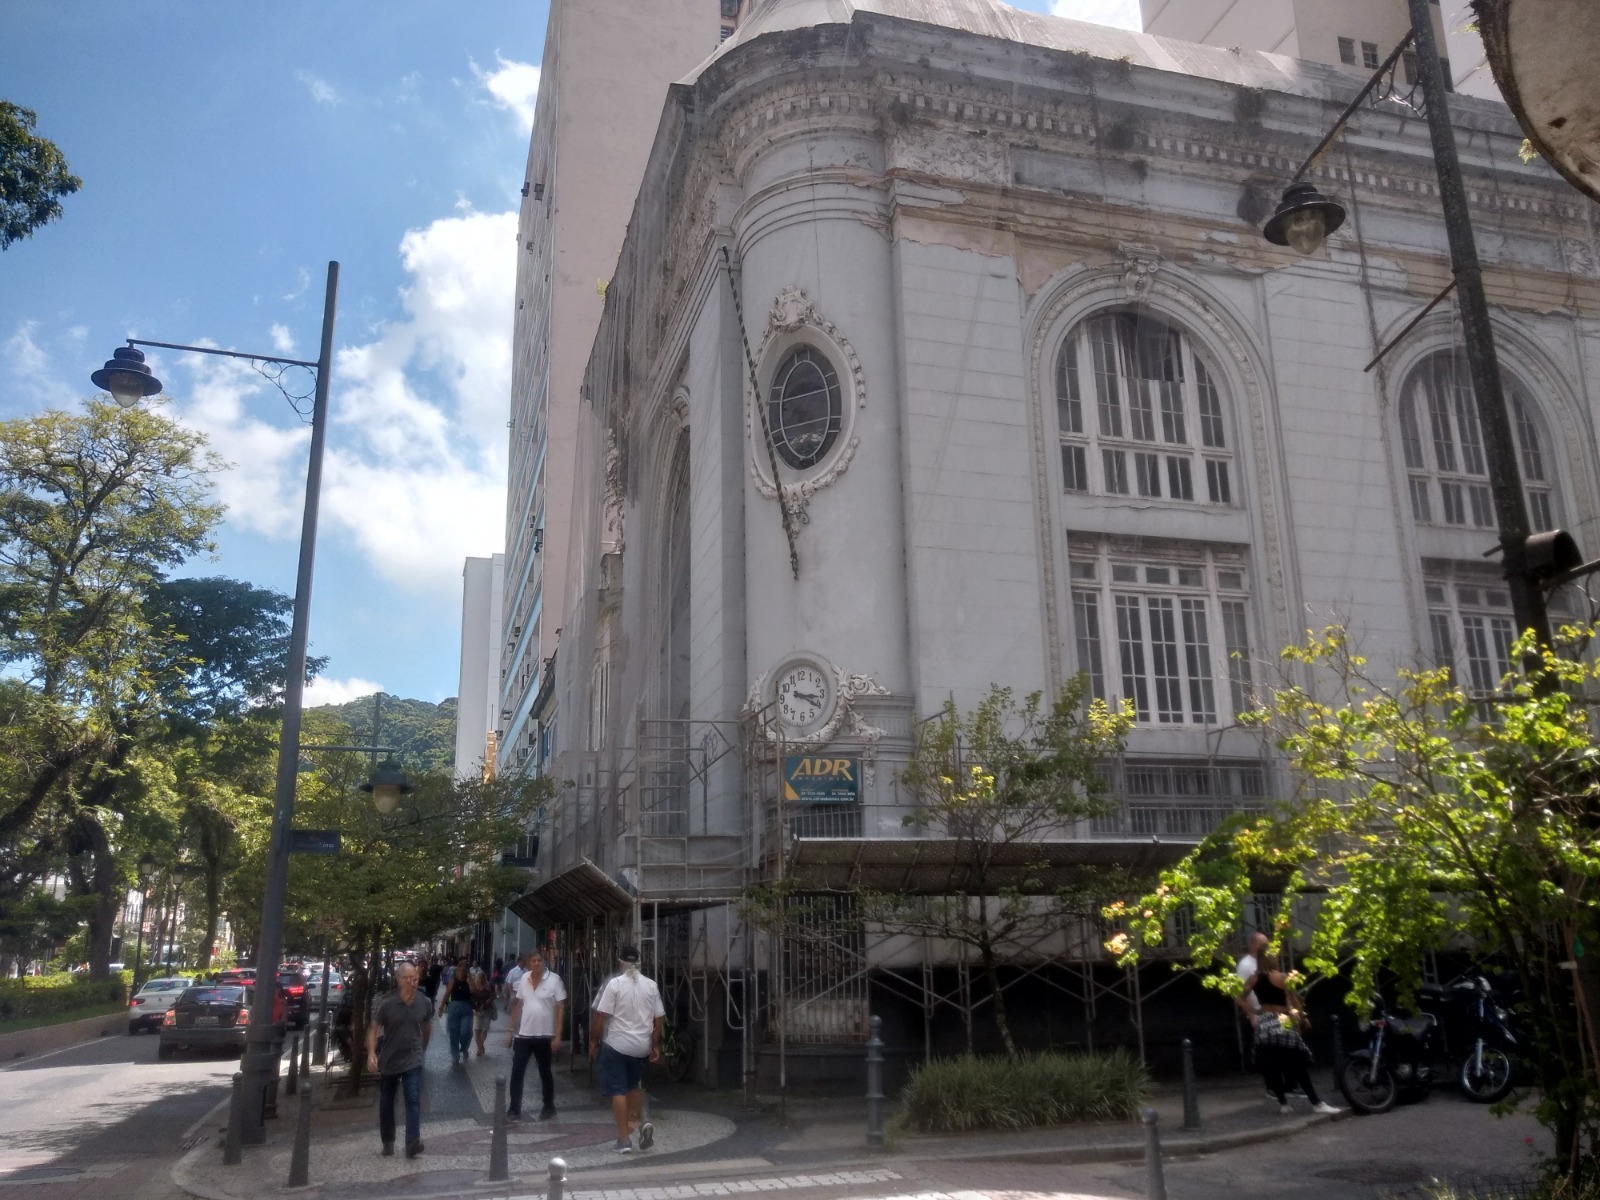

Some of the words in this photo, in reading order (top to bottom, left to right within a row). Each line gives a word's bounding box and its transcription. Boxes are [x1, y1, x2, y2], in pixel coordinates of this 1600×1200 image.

[790, 674, 796, 687] 11
[798, 670, 805, 681] 12
[809, 671, 812, 682] 1
[782, 682, 790, 694] 10
[815, 677, 821, 688] 2
[780, 694, 785, 704] 9
[820, 688, 825, 699] 3
[784, 704, 788, 714] 8
[790, 708, 796, 720] 7
[810, 708, 815, 718] 5
[800, 712, 805, 722] 6
[790, 758, 854, 781] ADR
